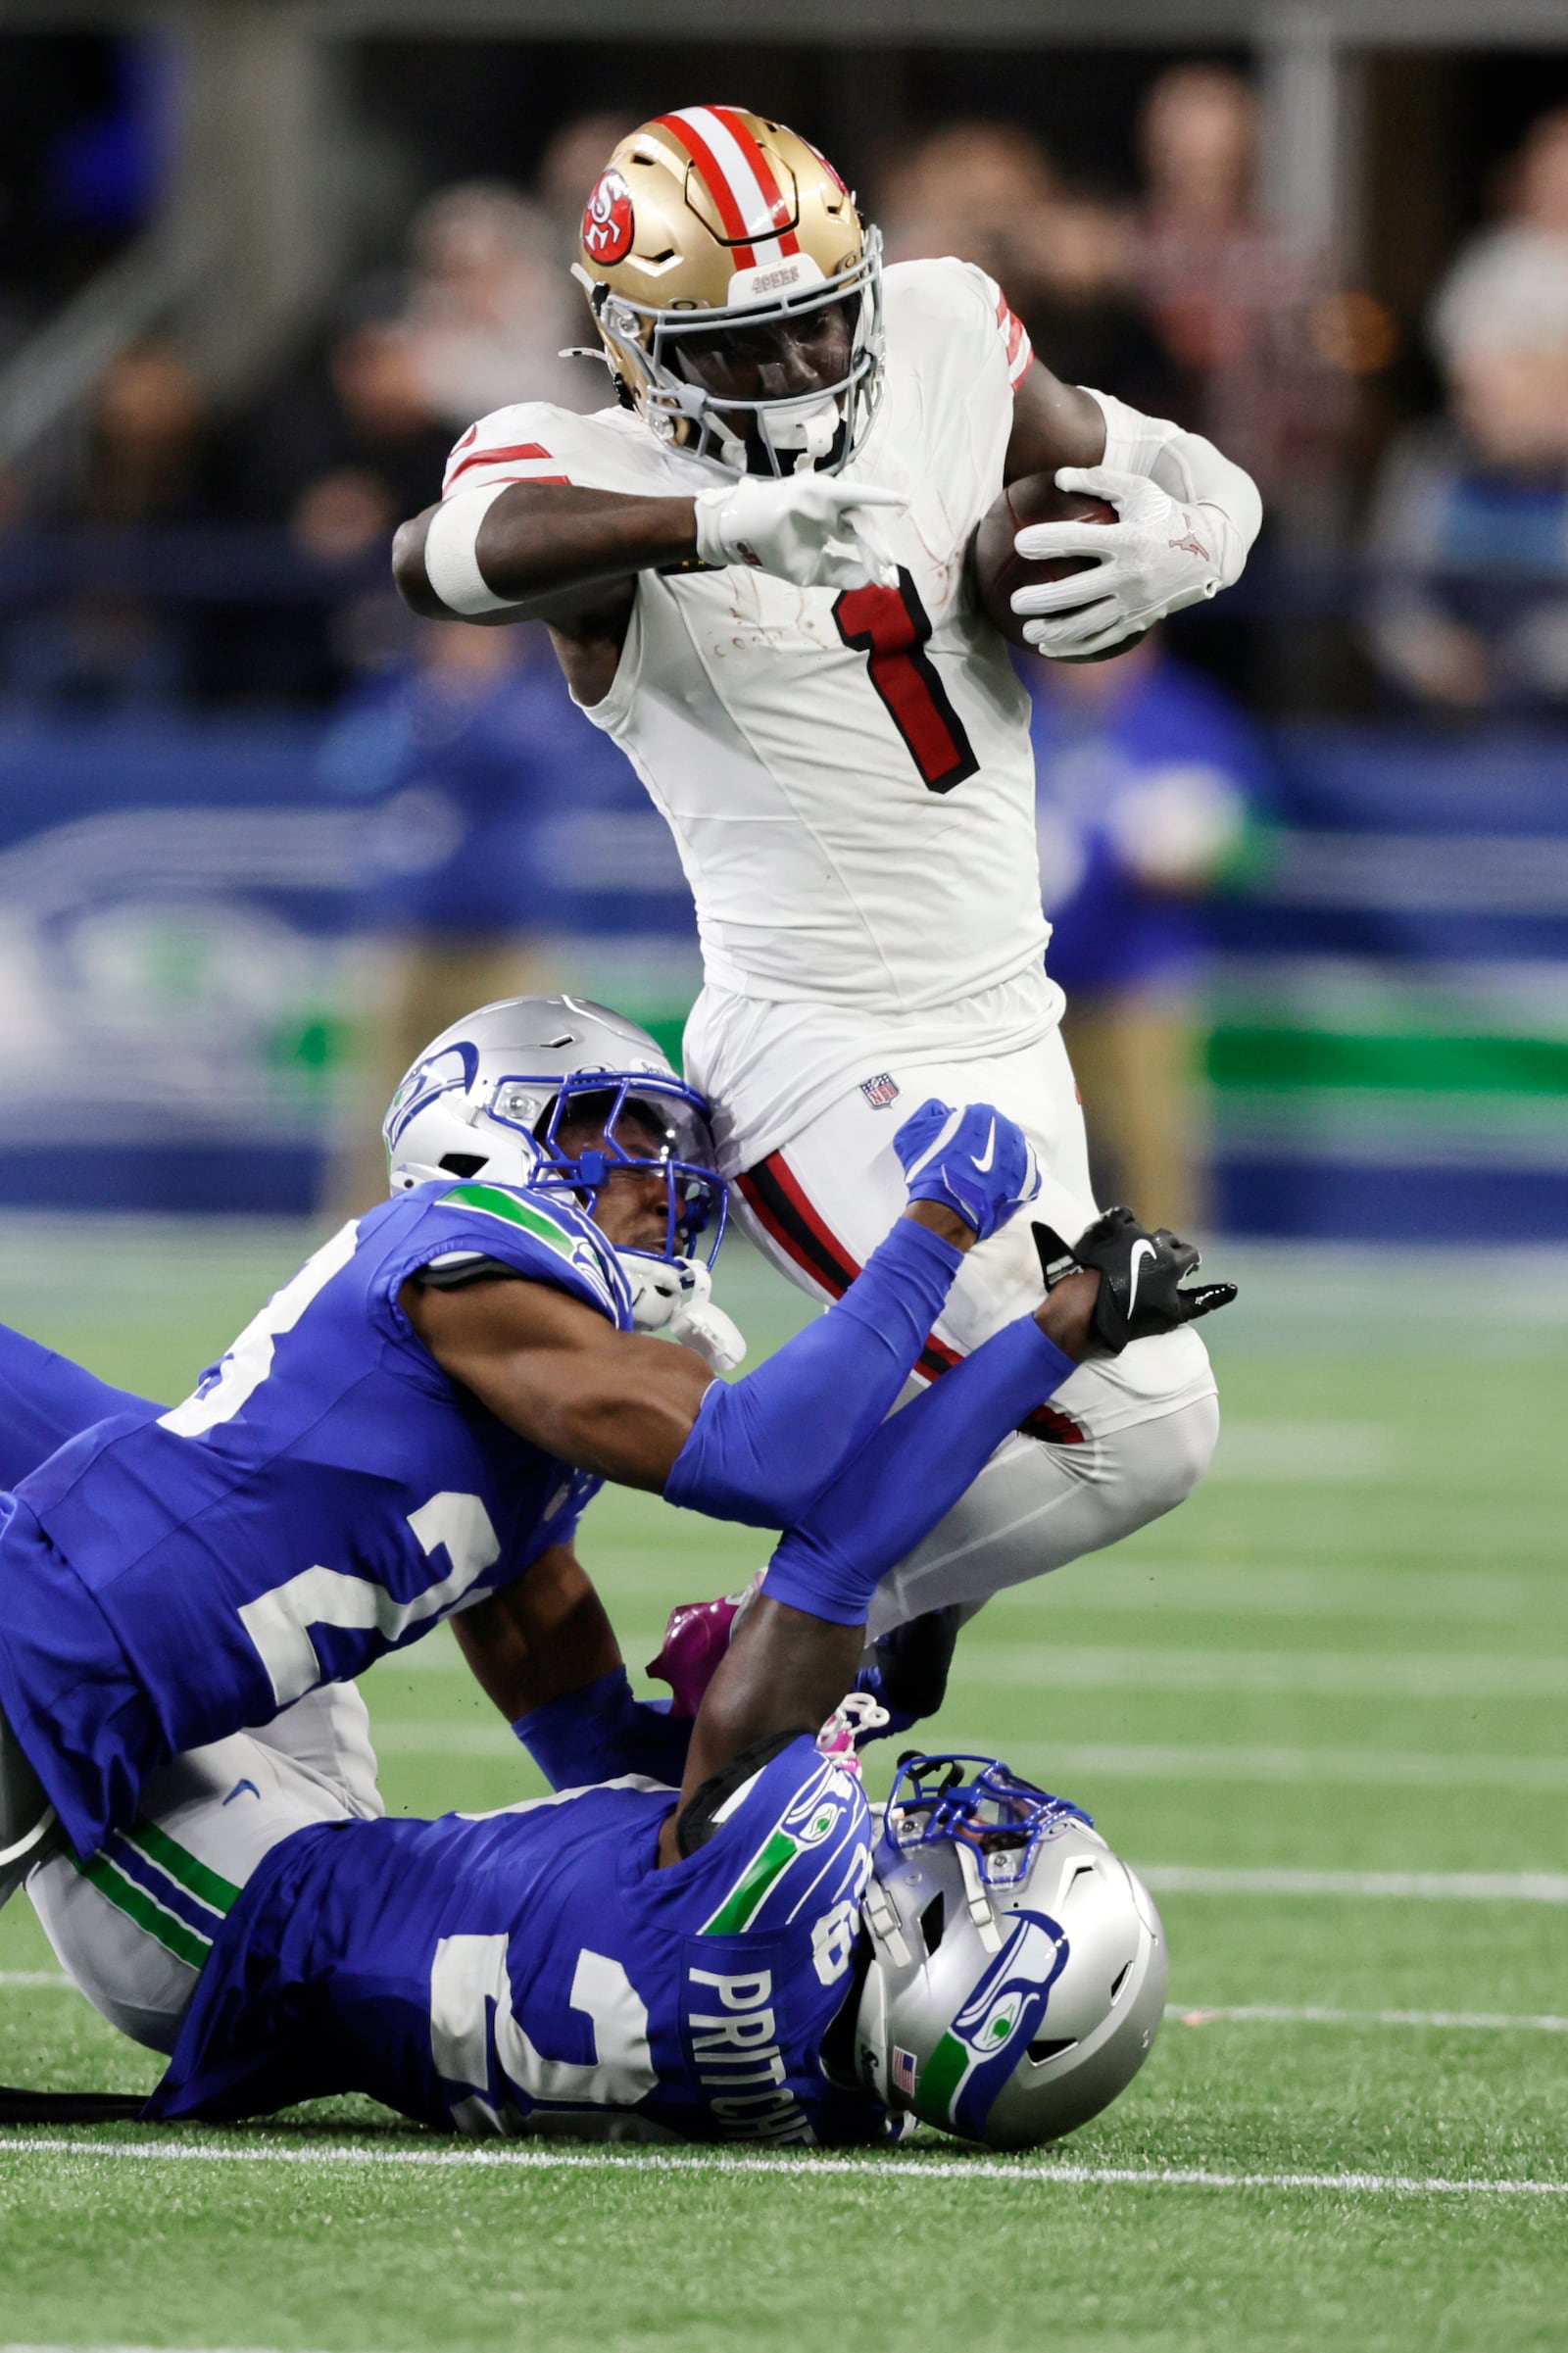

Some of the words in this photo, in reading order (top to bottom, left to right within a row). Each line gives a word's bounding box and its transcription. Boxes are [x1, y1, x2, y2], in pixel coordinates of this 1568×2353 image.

[831, 564, 980, 795] 1
[237, 1492, 502, 1707] 2
[430, 1933, 686, 2138] 2
